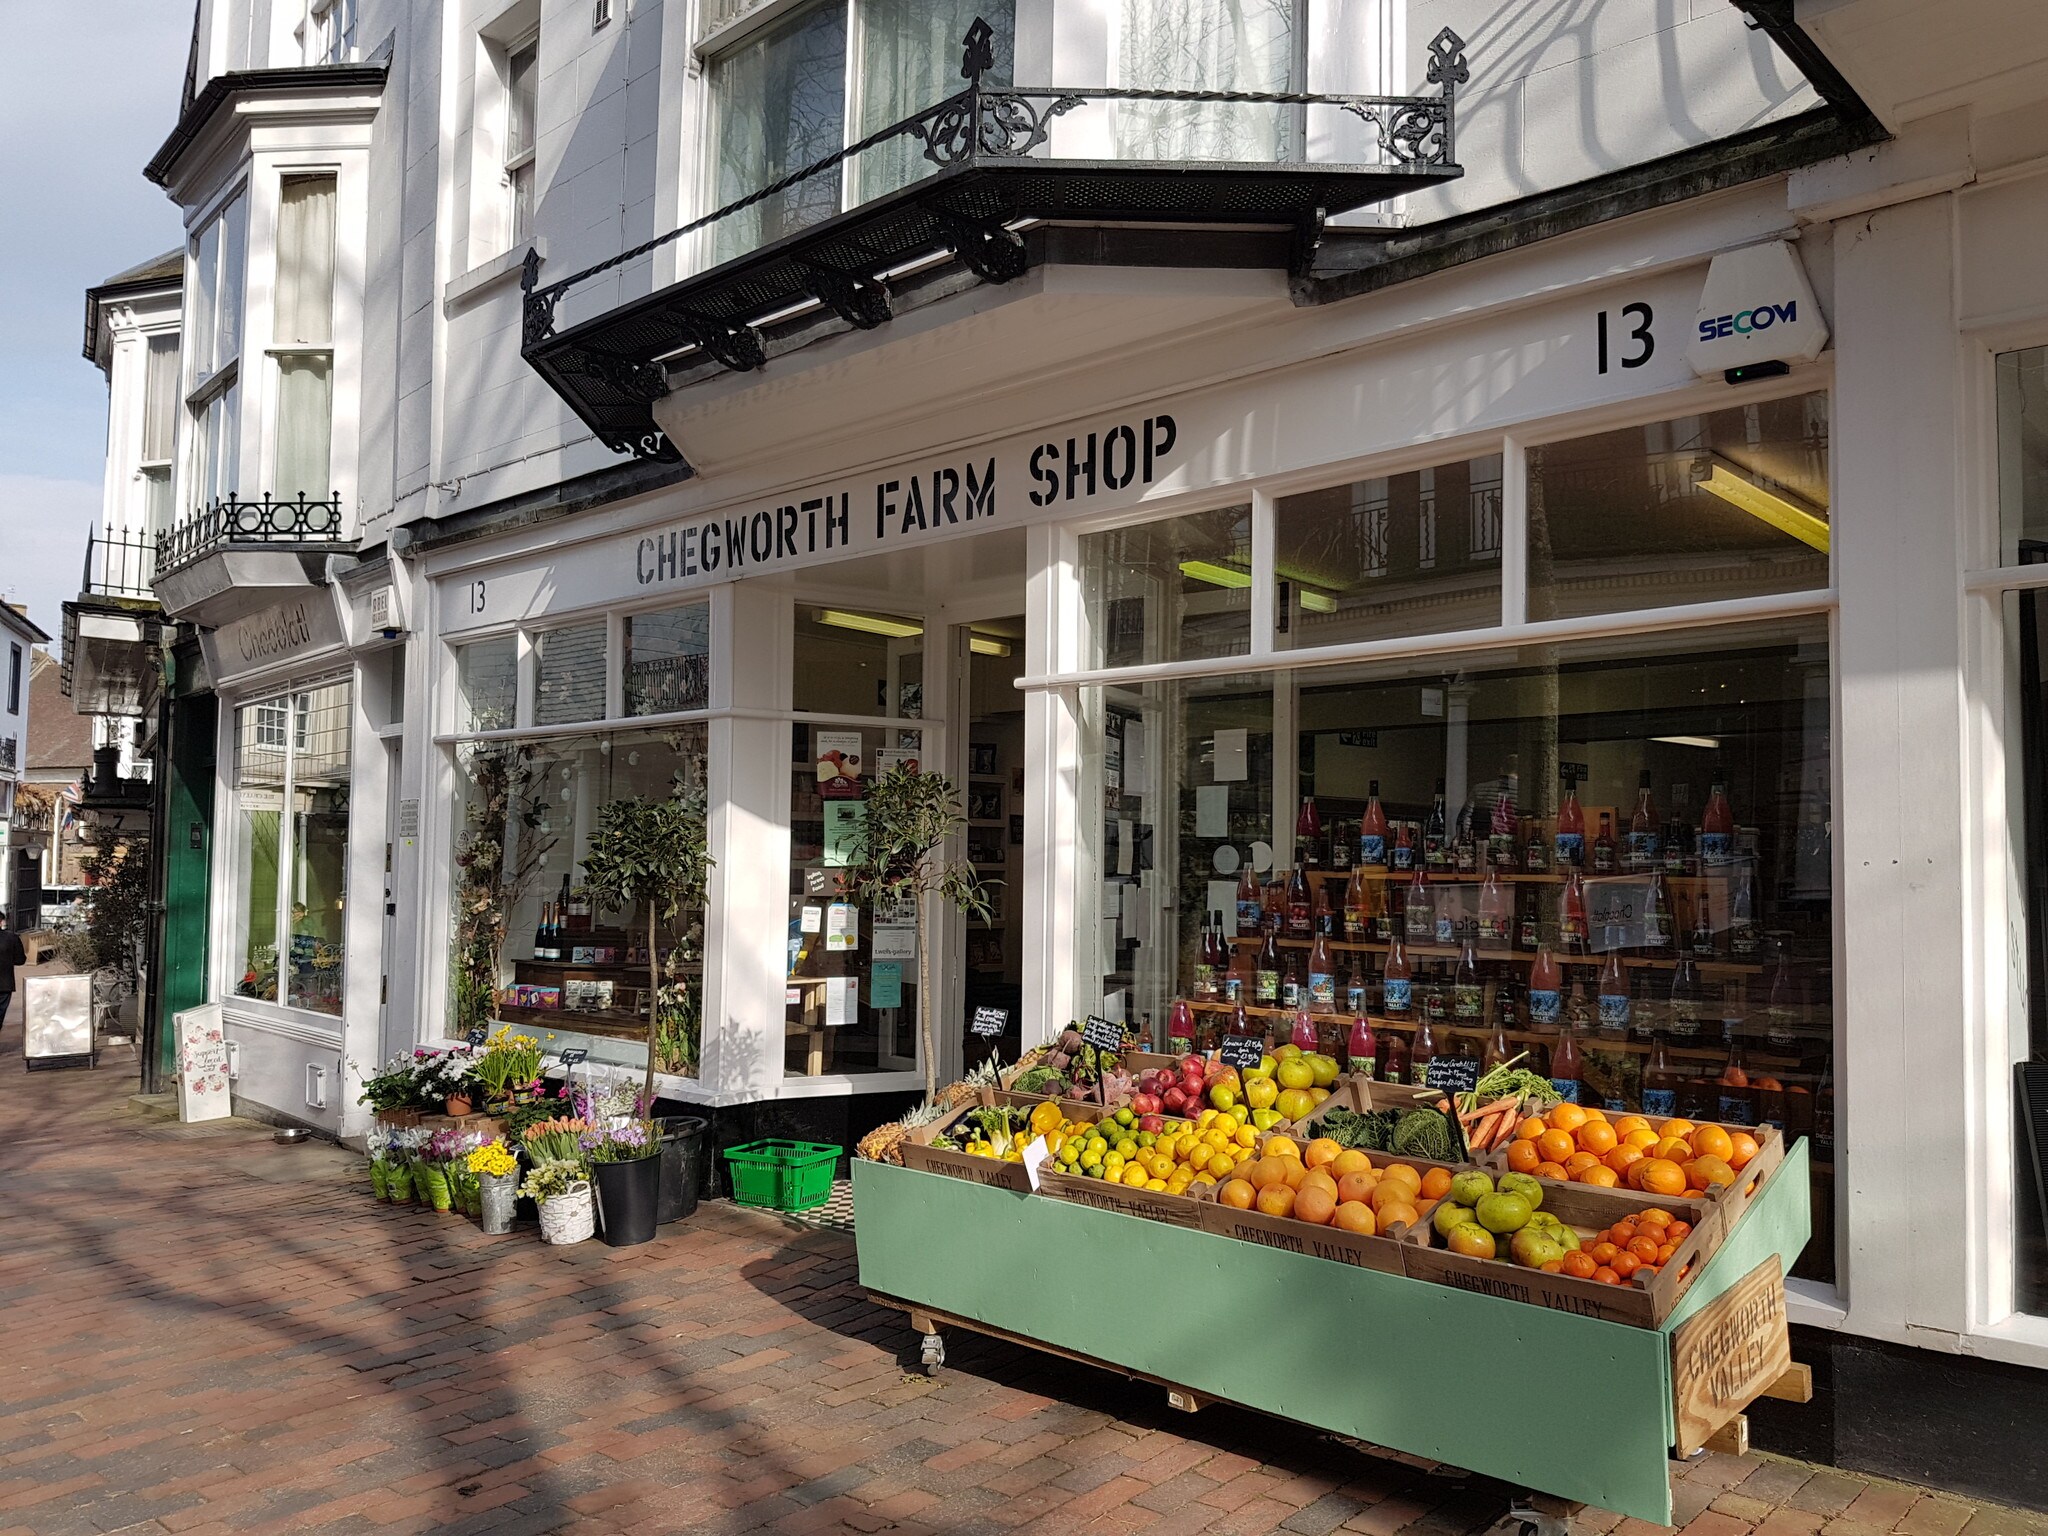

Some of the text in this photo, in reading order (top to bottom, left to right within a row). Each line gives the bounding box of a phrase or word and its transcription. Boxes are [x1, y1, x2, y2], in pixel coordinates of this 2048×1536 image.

[1597, 302, 1655, 375] 13
[1698, 300, 1798, 342] SECOM
[637, 415, 1178, 585] CHEGWORTH FARM SHOP
[471, 580, 486, 614] 13
[925, 1159, 1012, 1190] CHEGWORTH VALLEY
[1065, 1187, 1169, 1224] CHEGWORTH VALLEY
[1234, 1223, 1362, 1267] CHEGWORTH VALLEY
[1445, 1269, 1603, 1320] CHEGWORTH VALLEY
[1688, 1282, 1778, 1382] CHEGWORTH
[1710, 1335, 1765, 1409] VALLEY
